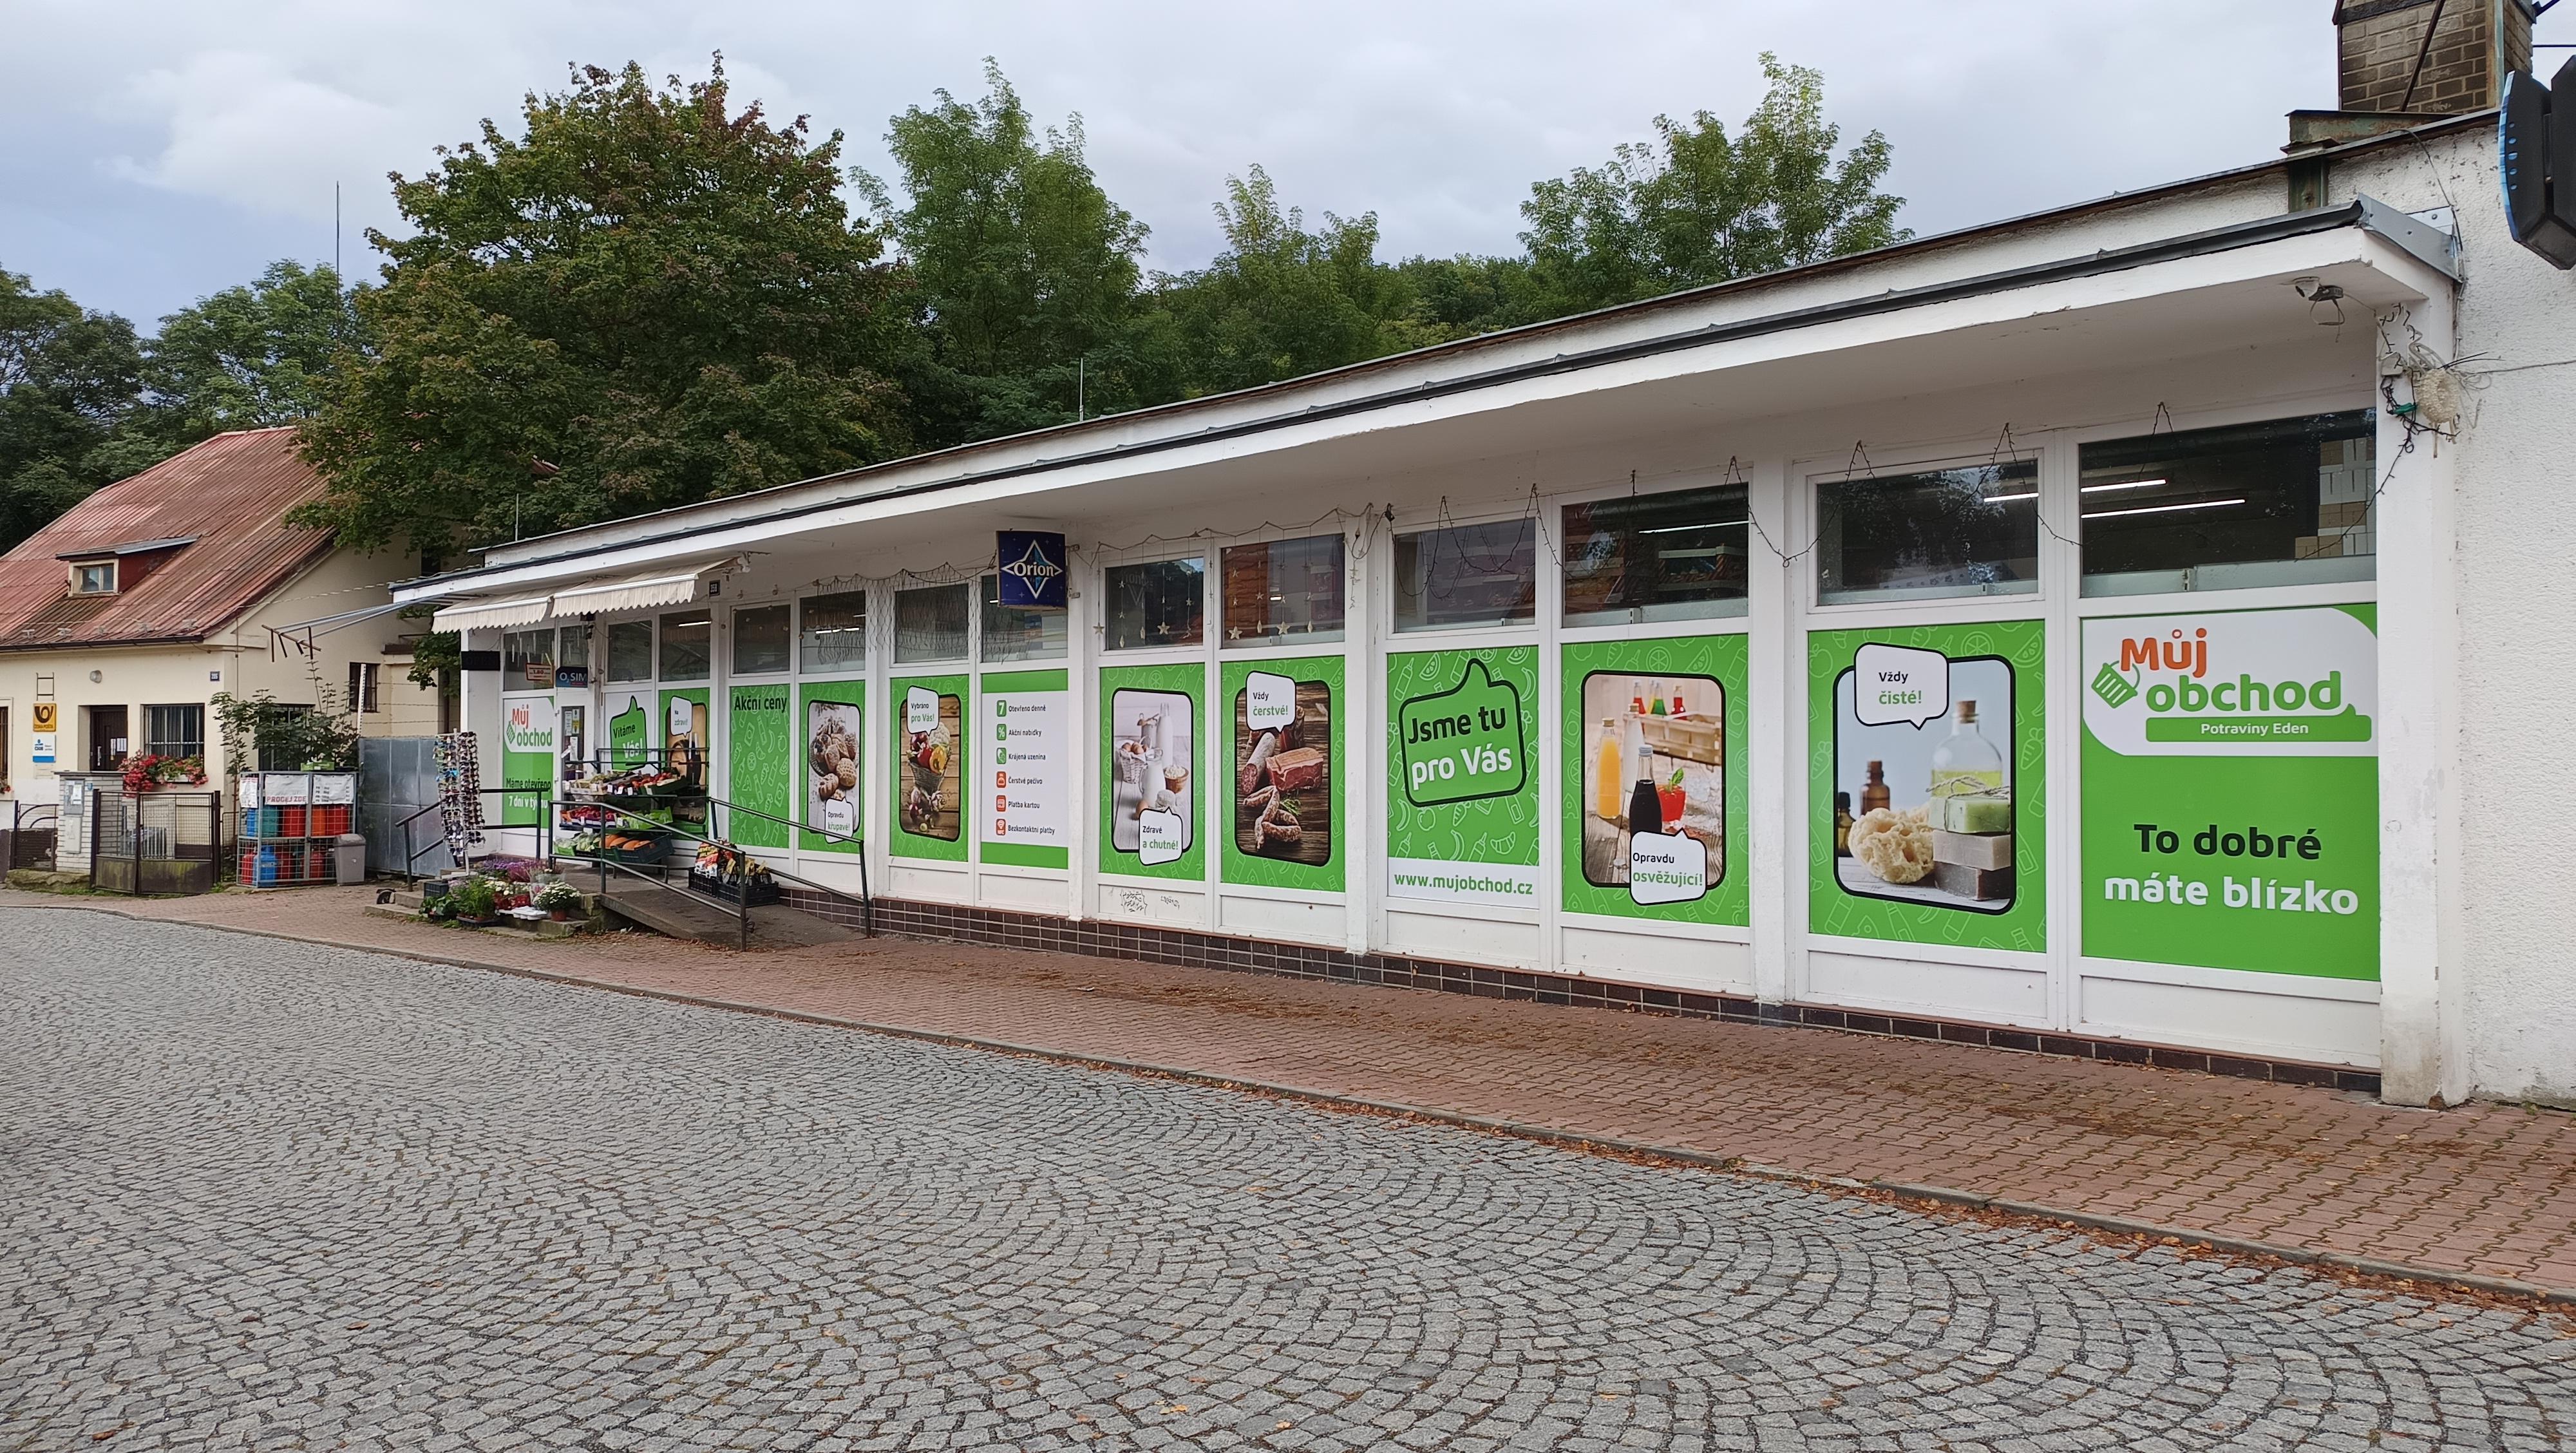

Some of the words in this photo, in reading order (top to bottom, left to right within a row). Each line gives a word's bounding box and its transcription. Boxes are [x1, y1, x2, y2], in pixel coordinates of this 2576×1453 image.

[1014, 562, 1054, 577] Orion
[2121, 627, 2208, 678] Můj
[570, 672, 587, 681] SIM
[1879, 671, 1908, 684] Vždy
[1253, 692, 1269, 701] Vždy
[1879, 690, 1922, 705] čisté!
[2146, 670, 2342, 712] obchod
[734, 696, 761, 710] Akční
[764, 698, 788, 714] ceny
[911, 702, 929, 710] Vybráno
[1253, 705, 1288, 716] čerstvé!
[512, 704, 529, 729] Můj
[911, 715, 921, 724] pro
[922, 713, 934, 722] Vás!
[612, 724, 636, 739] Vítáme
[1408, 714, 1472, 744] Jsme
[1478, 706, 1506, 732] tu
[2201, 723, 2269, 737] Potraviny
[2273, 723, 2309, 734] Eden
[516, 727, 553, 747] obchod
[1023, 728, 1042, 737] nabídky
[623, 738, 643, 759] Vás!
[1009, 753, 1027, 761] Krájená
[1412, 757, 1455, 791] pro
[1460, 743, 1512, 775] Vás
[506, 777, 524, 788] Máme
[524, 778, 551, 790] otevřeno
[1009, 776, 1026, 784] Čerstvé
[509, 795, 513, 806] 7
[514, 795, 524, 807] dní
[525, 798, 529, 808] v
[529, 796, 548, 810] týnu
[828, 822, 850, 831] křupavé!
[1039, 826, 1056, 835] platby
[1142, 826, 1162, 834] Zdravé
[1150, 839, 1179, 850] chutné!
[2134, 824, 2179, 854] To
[2193, 824, 2322, 860] dobré
[1633, 852, 1674, 864] Opravdu
[1394, 874, 1533, 895] www.mujobchod.cz
[1633, 871, 1703, 888] osvěžující!
[2105, 871, 2208, 906] máte
[2223, 876, 2359, 915] blízko
